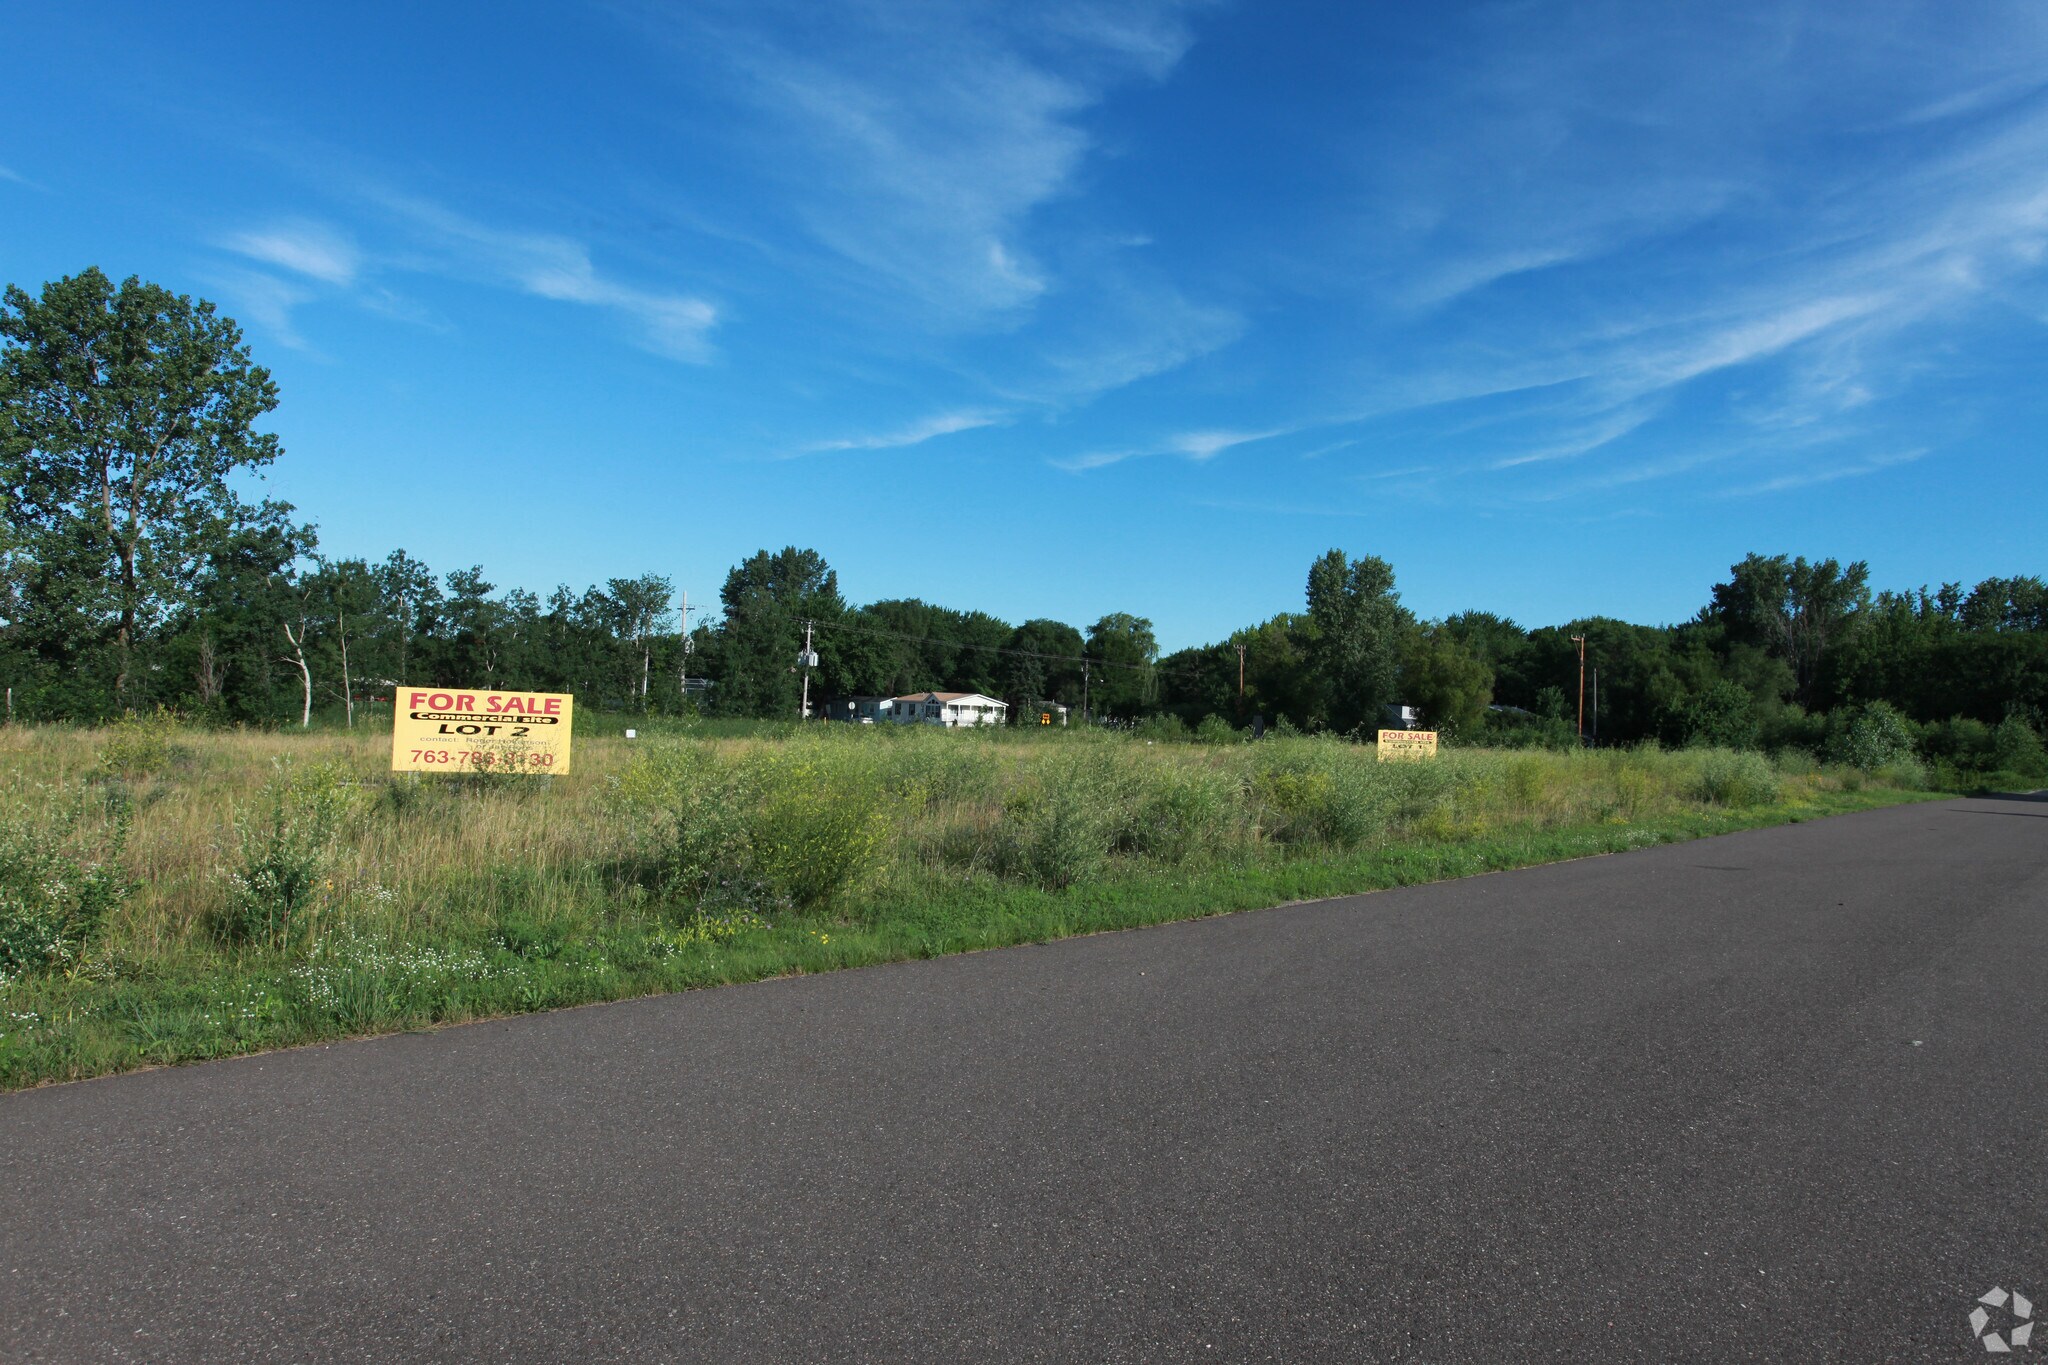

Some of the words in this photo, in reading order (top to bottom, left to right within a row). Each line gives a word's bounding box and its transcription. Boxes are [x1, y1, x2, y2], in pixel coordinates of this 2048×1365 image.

[409, 692, 475, 711] FOR
[486, 695, 562, 715] SALE
[417, 712, 518, 723] Commercial
[522, 716, 552, 724] site
[438, 724, 502, 736] LOT
[510, 726, 530, 737] 2
[1382, 732, 1404, 740] FOR
[1408, 733, 1433, 741] SALE
